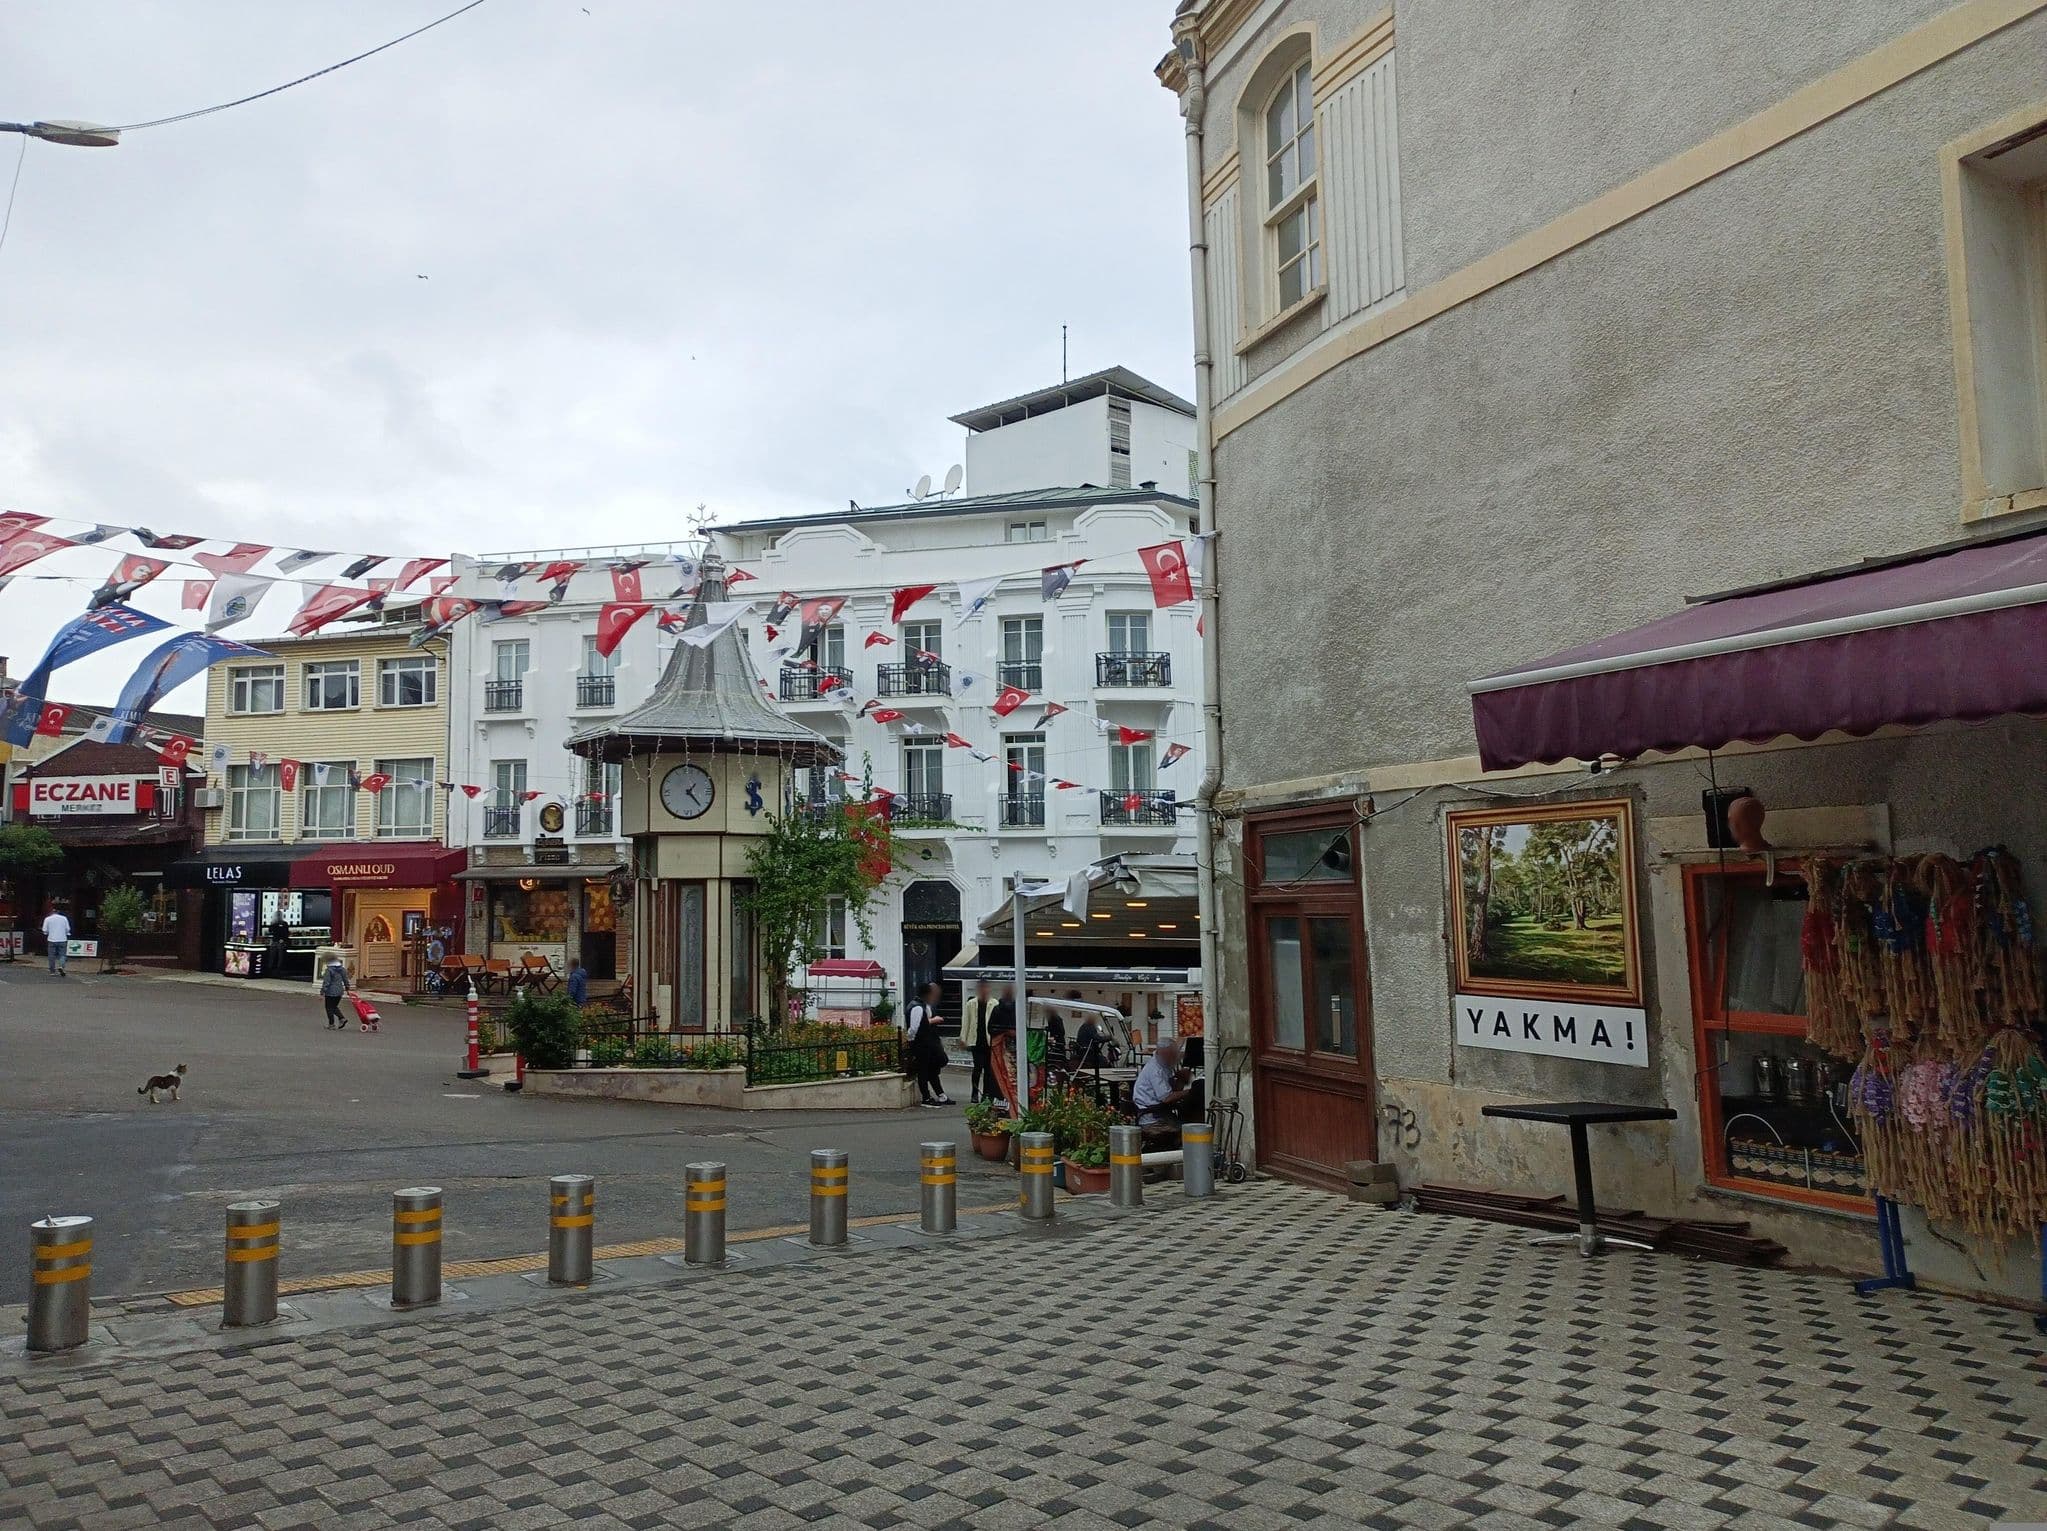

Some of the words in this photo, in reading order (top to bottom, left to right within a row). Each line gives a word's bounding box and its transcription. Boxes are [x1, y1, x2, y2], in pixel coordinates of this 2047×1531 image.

[165, 771, 175, 784] E
[34, 783, 130, 802] ECZANE
[206, 866, 242, 879] LELAS
[327, 864, 370, 875] OSMANLI
[372, 864, 395, 874] OUD
[86, 943, 93, 952] E
[1466, 1007, 1635, 1050] YAKMA!
[1382, 1103, 1421, 1149] 73
